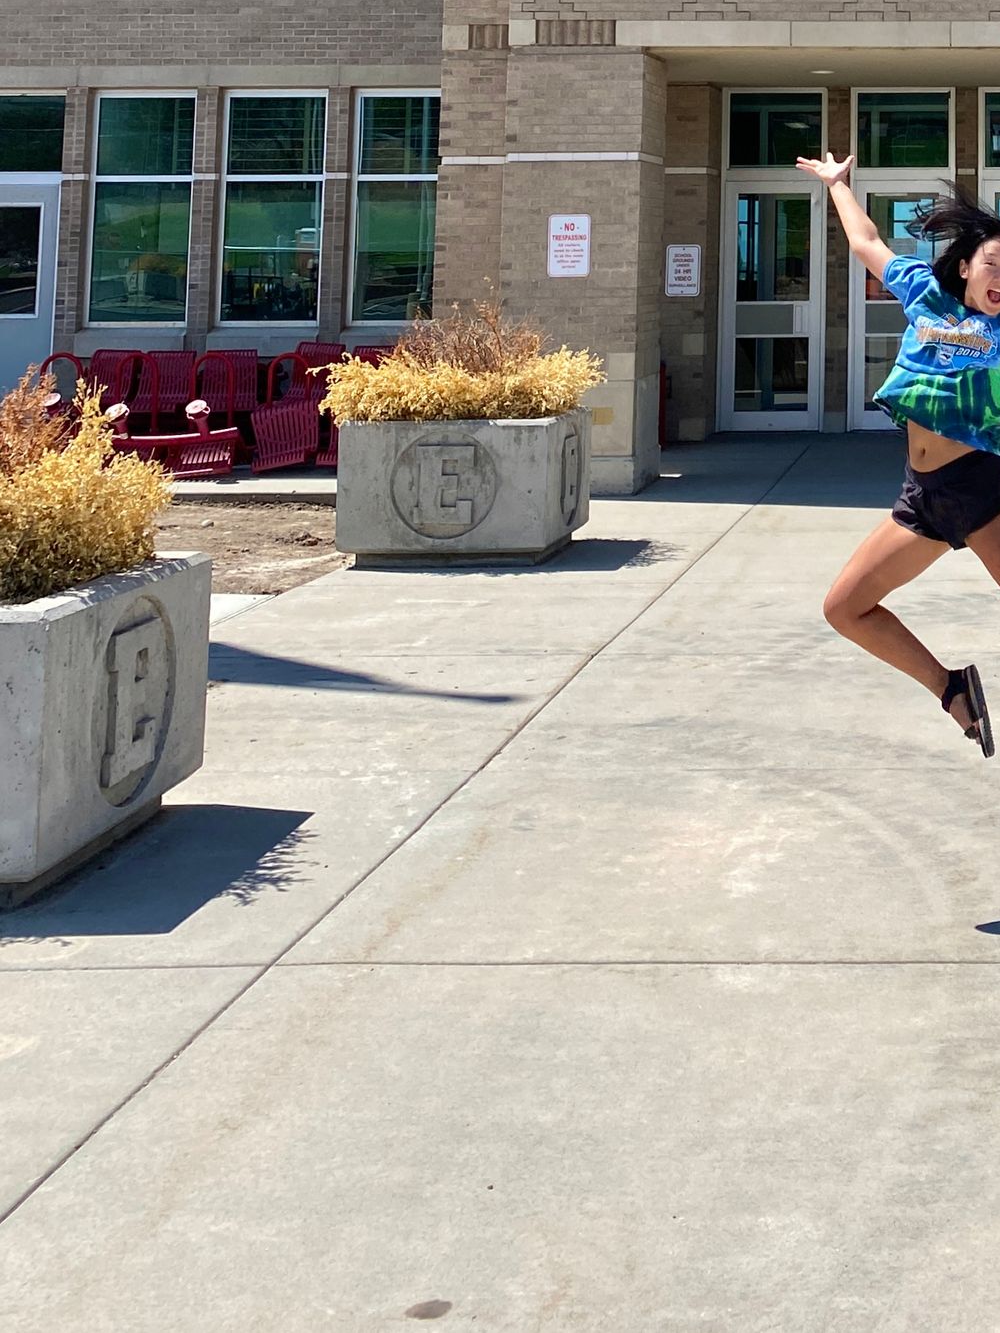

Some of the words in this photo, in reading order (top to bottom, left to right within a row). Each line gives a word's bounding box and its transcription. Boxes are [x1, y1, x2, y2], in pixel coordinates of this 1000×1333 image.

[564, 223, 575, 231] NO
[413, 443, 476, 524] E
[107, 617, 168, 788] E
